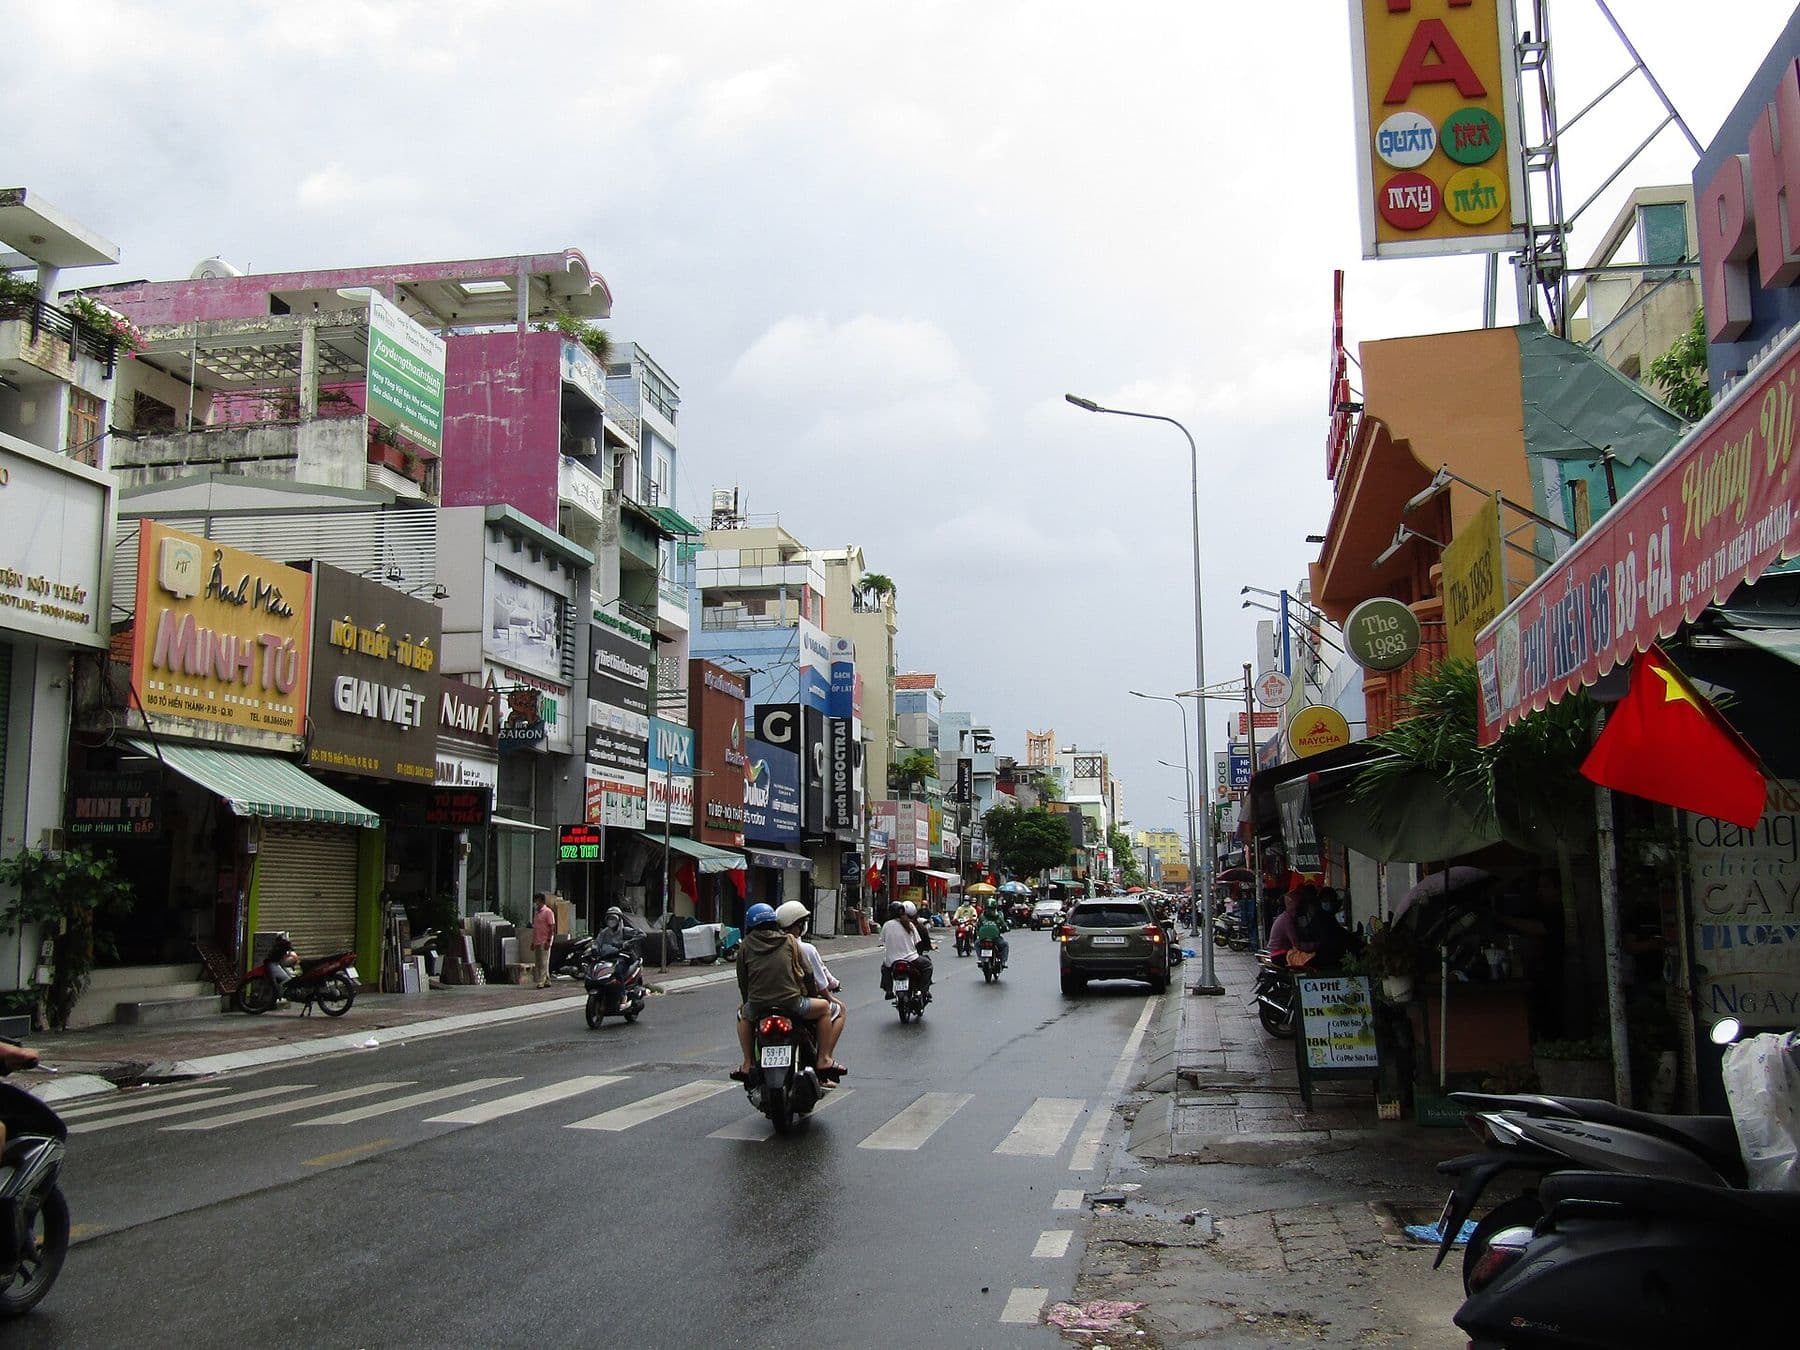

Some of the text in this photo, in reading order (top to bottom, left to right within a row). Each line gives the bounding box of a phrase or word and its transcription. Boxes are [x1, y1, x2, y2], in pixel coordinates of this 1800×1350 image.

[1362, 614, 1407, 658] The 1983
[152, 608, 300, 695] MINH TÚ
[498, 728, 543, 739] SAIGON
[763, 711, 792, 743] G
[1299, 735, 1341, 746] MAYCHA
[656, 727, 690, 767] INAX
[1218, 761, 1226, 784] OCB
[1304, 1007, 1325, 1017] 15K
